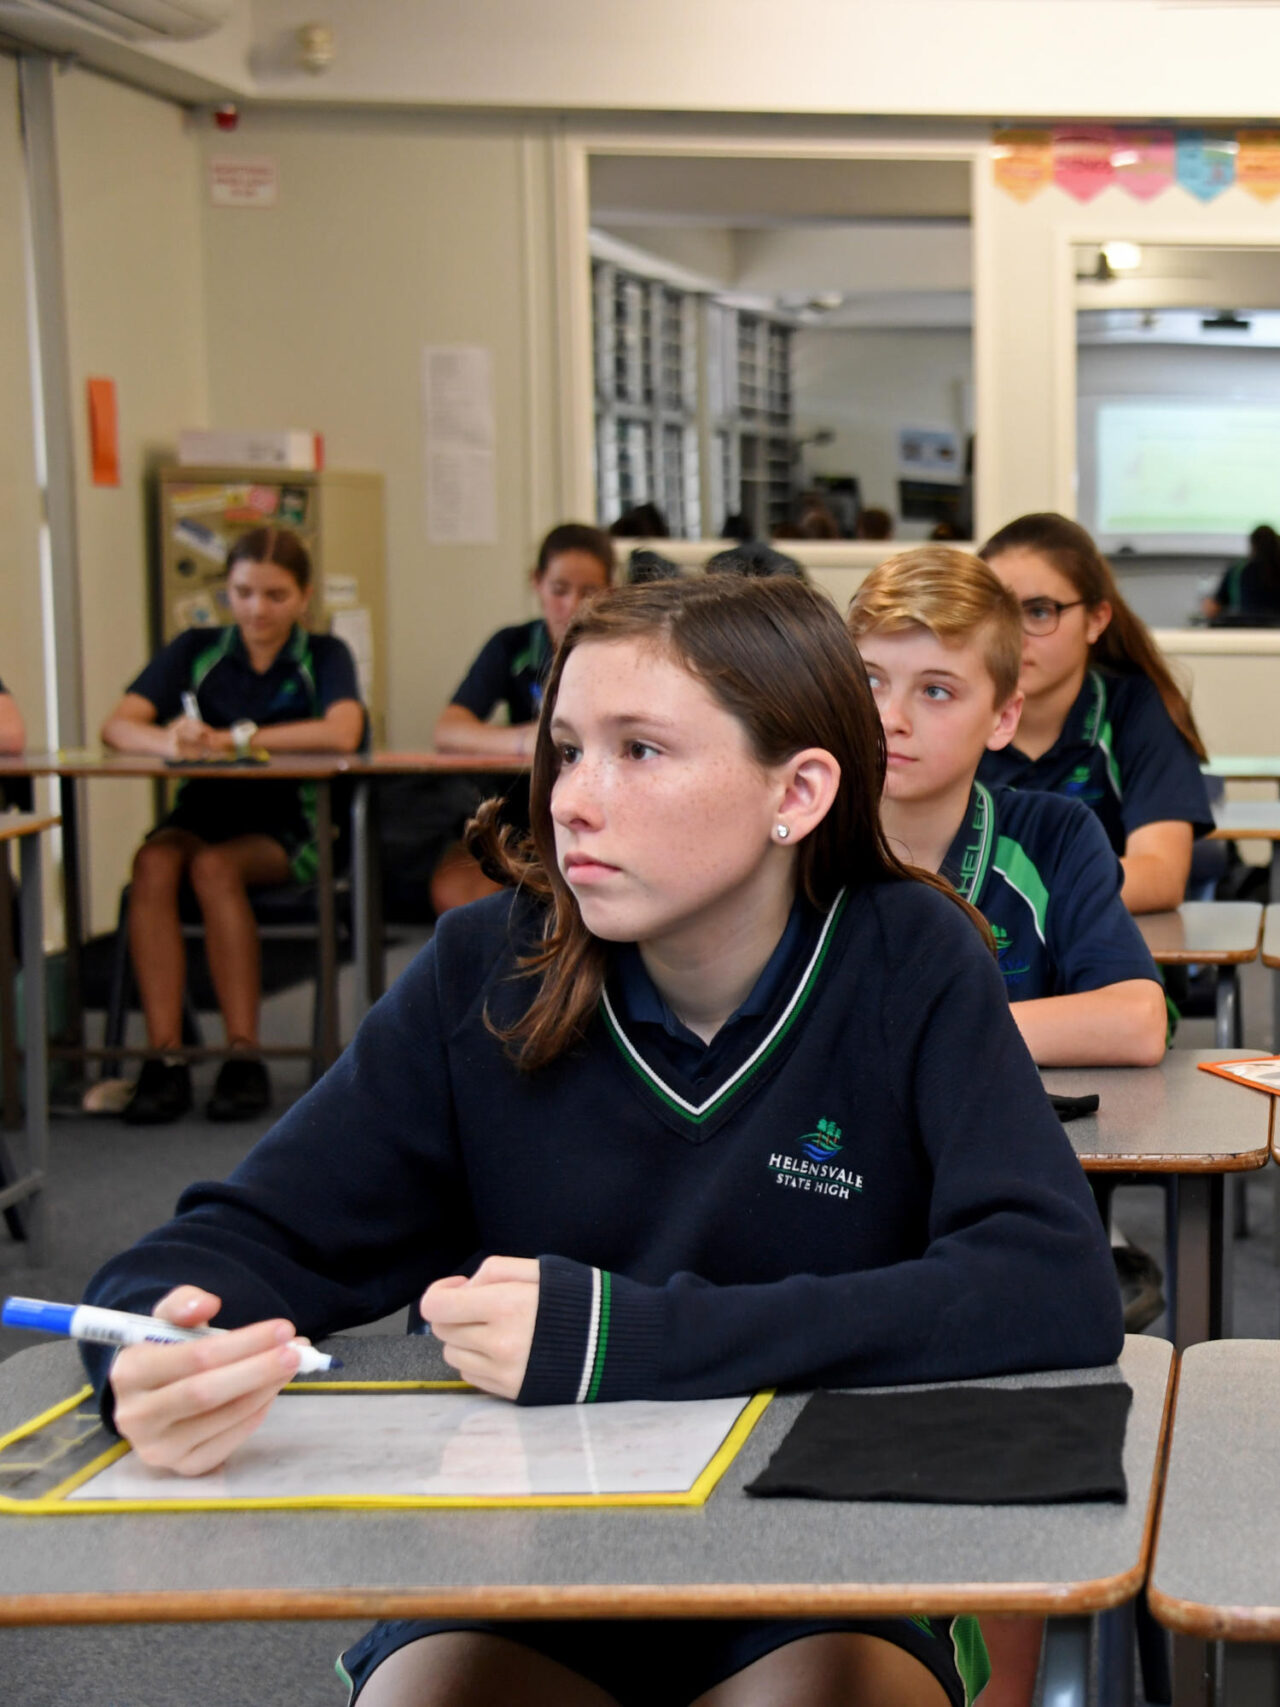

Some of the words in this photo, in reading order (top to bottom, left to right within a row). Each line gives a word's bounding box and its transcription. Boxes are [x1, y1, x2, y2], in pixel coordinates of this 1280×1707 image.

[768, 1153, 863, 1188] HELENSVALE
[776, 1173, 812, 1190] STATE
[814, 1181, 850, 1199] HIGH
